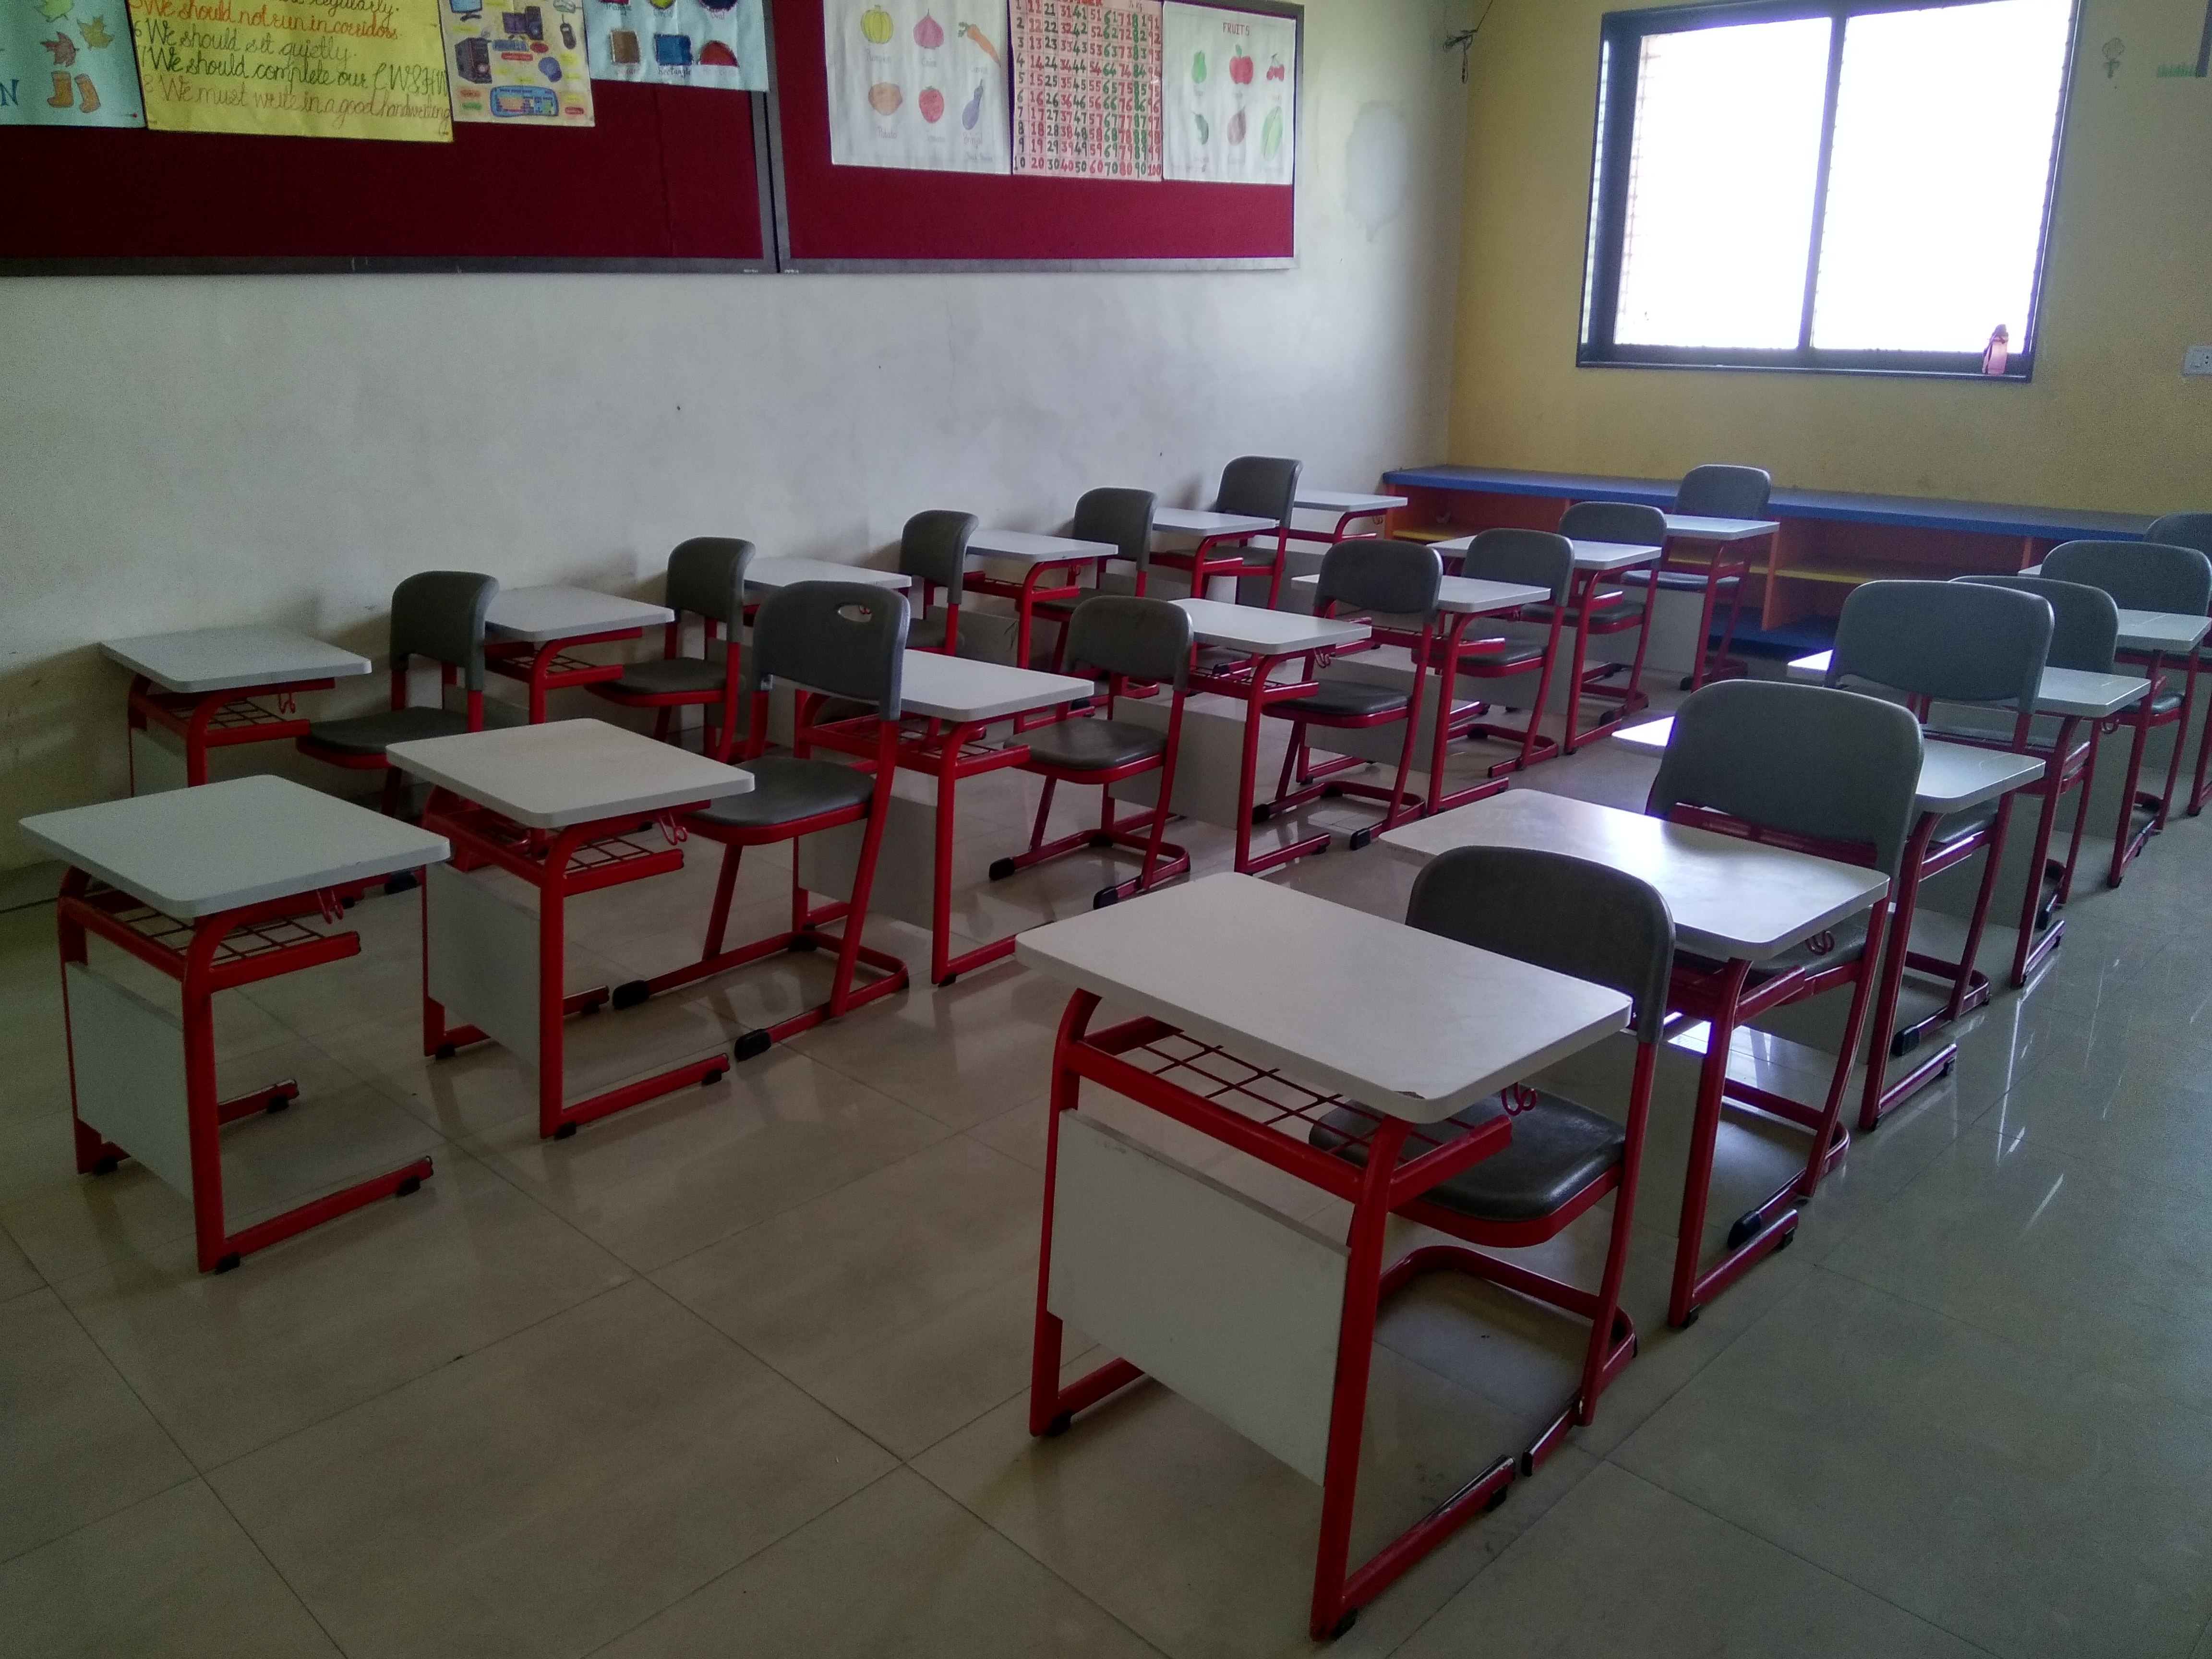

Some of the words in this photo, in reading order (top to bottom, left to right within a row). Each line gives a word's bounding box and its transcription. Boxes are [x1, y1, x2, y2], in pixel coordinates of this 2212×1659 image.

[179, 0, 237, 22] should
[240, 4, 273, 26] not
[272, 13, 306, 31] run
[310, 15, 335, 33] in
[1044, 3, 1056, 16] 21
[1060, 5, 1071, 18] 31
[1072, 5, 1086, 20] 41
[1091, 9, 1101, 21] 51
[1104, 10, 1118, 24] 61
[1118, 12, 1131, 26] 71
[133, 20, 143, 37] 6
[146, 18, 176, 45] We
[180, 23, 240, 51] should
[245, 32, 274, 55] sit
[1017, 17, 1024, 29] 2
[1029, 18, 1043, 33] 12
[1044, 20, 1058, 33] 22
[1061, 23, 1072, 34] 32
[1072, 22, 1087, 37] 42
[1091, 25, 1103, 37] 52
[1104, 24, 1118, 39] 62
[1119, 29, 1131, 40] 72
[1223, 22, 1250, 36] FRUITS
[1018, 37, 1024, 48] 3
[1030, 36, 1042, 49] 13
[1045, 36, 1057, 49] 23
[1061, 40, 1072, 52] 33
[1073, 41, 1087, 56] 43
[1090, 43, 1102, 56] 53
[1104, 43, 1117, 57] 63
[1118, 46, 1132, 59] 73
[146, 47, 183, 72] We
[186, 49, 249, 78] should
[251, 58, 336, 95] complete
[338, 71, 369, 88] our
[1017, 53, 1025, 68] 4
[1031, 55, 1044, 71] 14
[1045, 56, 1057, 71] 24
[1060, 59, 1071, 72] 34
[1072, 59, 1086, 73] 44
[1090, 61, 1102, 76] 54
[1103, 62, 1117, 77] 64
[1119, 63, 1131, 78] 74
[1133, 64, 1146, 78] 84
[1019, 72, 1025, 84] 5
[1030, 73, 1043, 86] 15
[1045, 75, 1058, 87] 25
[1061, 77, 1071, 88] 35
[1073, 78, 1086, 92] 45
[1089, 80, 1101, 91] 55
[1103, 80, 1117, 94] 65
[1118, 82, 1132, 96] 75
[159, 74, 192, 102] We
[194, 81, 248, 107] must
[255, 84, 300, 111] write
[301, 90, 325, 114] in
[325, 98, 339, 113] a
[333, 89, 377, 130] good
[1017, 88, 1023, 102] 6
[1031, 91, 1043, 105] 16
[1046, 92, 1058, 108] 26
[1061, 94, 1072, 108] 36
[1074, 95, 1086, 108] 46
[1089, 96, 1101, 109] 56
[1104, 96, 1117, 110] 66
[1119, 97, 1132, 113] 76
[1018, 106, 1023, 118] 7
[1031, 107, 1044, 120] 17
[1046, 109, 1058, 121] 27
[1060, 110, 1072, 123] 37
[1074, 110, 1086, 124] 47
[1089, 113, 1102, 128] 57
[1105, 112, 1118, 128] 67
[1118, 115, 1132, 129] 77
[1134, 113, 1146, 129] 87
[1018, 120, 1024, 134] 8
[1031, 122, 1044, 136] 18
[1047, 124, 1059, 136] 28
[1061, 125, 1072, 139] 38
[1074, 127, 1087, 140] 48
[1089, 128, 1102, 142] 58
[1105, 128, 1117, 142] 68
[1019, 137, 1024, 153] 9
[1032, 138, 1043, 153] 19
[1047, 140, 1058, 154] 29
[1061, 141, 1073, 156] 39
[1074, 141, 1087, 156] 49
[1090, 143, 1102, 157] 59
[1105, 143, 1117, 157] 69
[1119, 145, 1132, 160] 79
[1135, 144, 1146, 161] 89
[1149, 146, 1160, 161] 99
[1014, 156, 1025, 170] 10
[1031, 157, 1044, 169] 20
[1047, 158, 1059, 170] 30
[1061, 158, 1074, 171] 40
[1075, 160, 1086, 173] 50
[1090, 160, 1103, 173] 60
[1105, 161, 1118, 176] 70
[1119, 161, 1132, 176] 80
[1135, 162, 1146, 179] 90
[1148, 164, 1161, 176] 100
